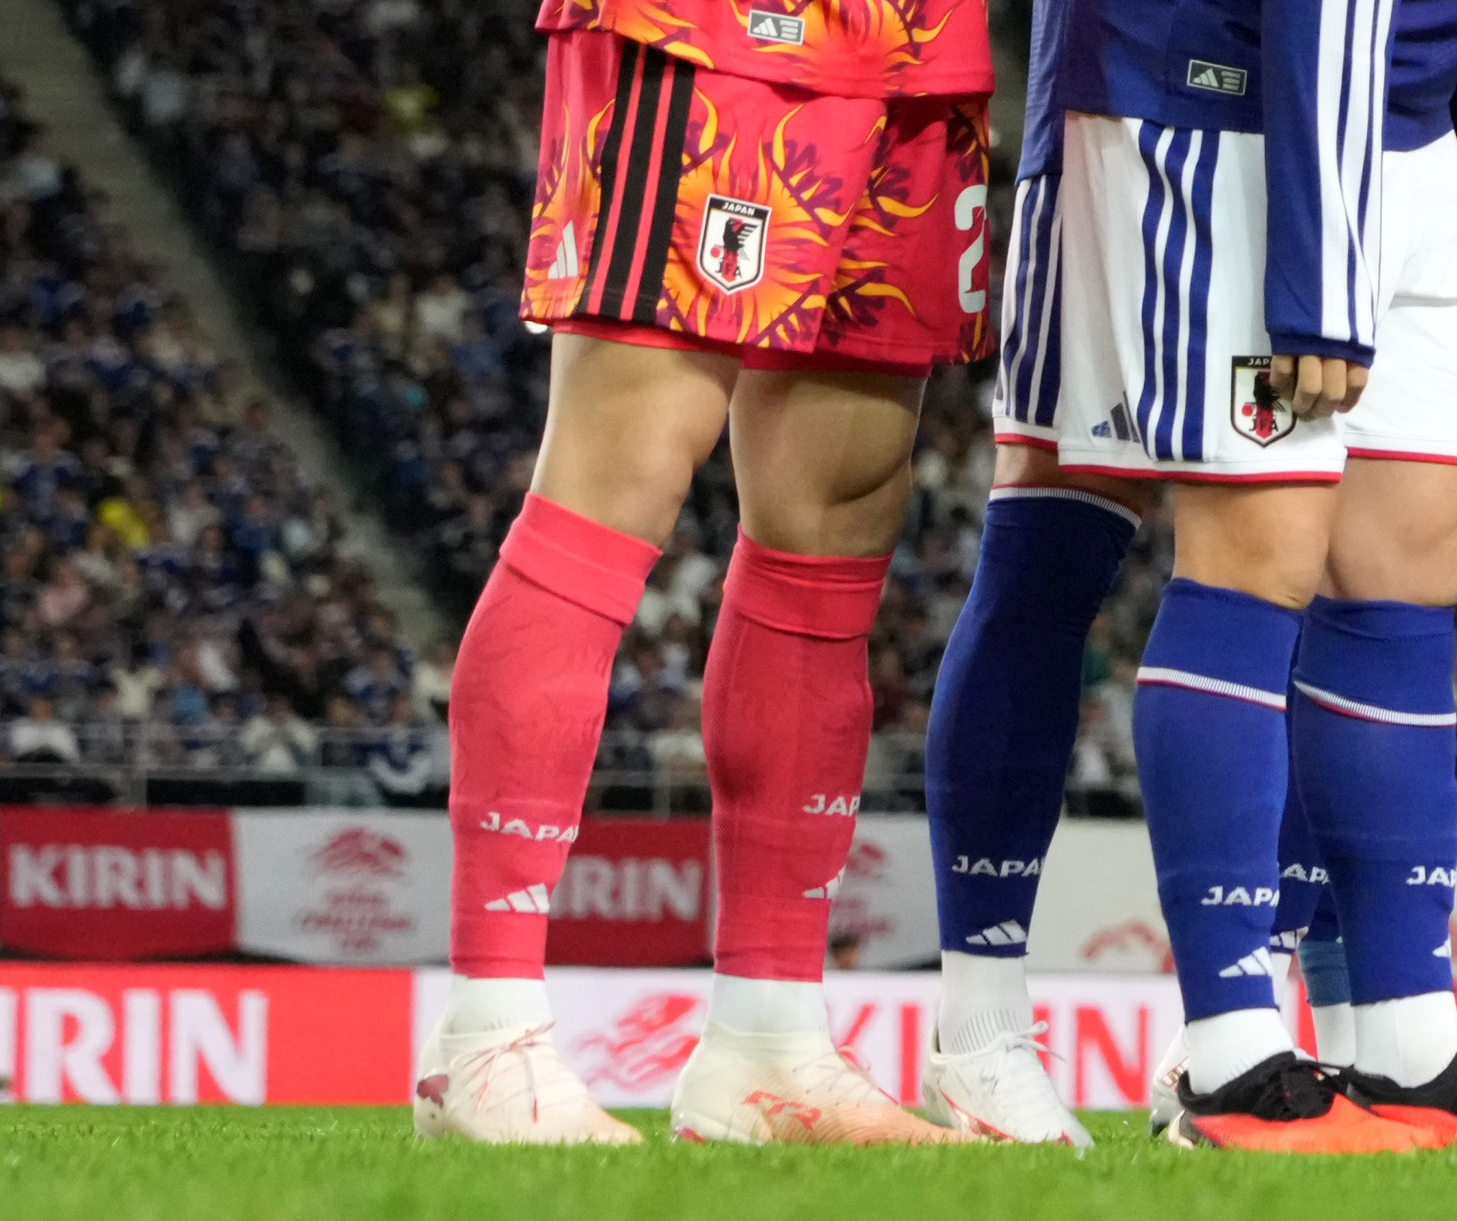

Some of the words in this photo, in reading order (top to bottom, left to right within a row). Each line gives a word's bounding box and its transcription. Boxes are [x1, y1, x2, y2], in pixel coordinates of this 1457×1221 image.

[721, 201, 755, 216] JAPAN
[1248, 358, 1272, 367] JAP
[803, 794, 861, 816] JAP
[480, 811, 579, 843] JAPA
[9, 842, 227, 911] KIRIN
[952, 855, 1044, 878] JAPA
[0, 987, 270, 1106] RIN
